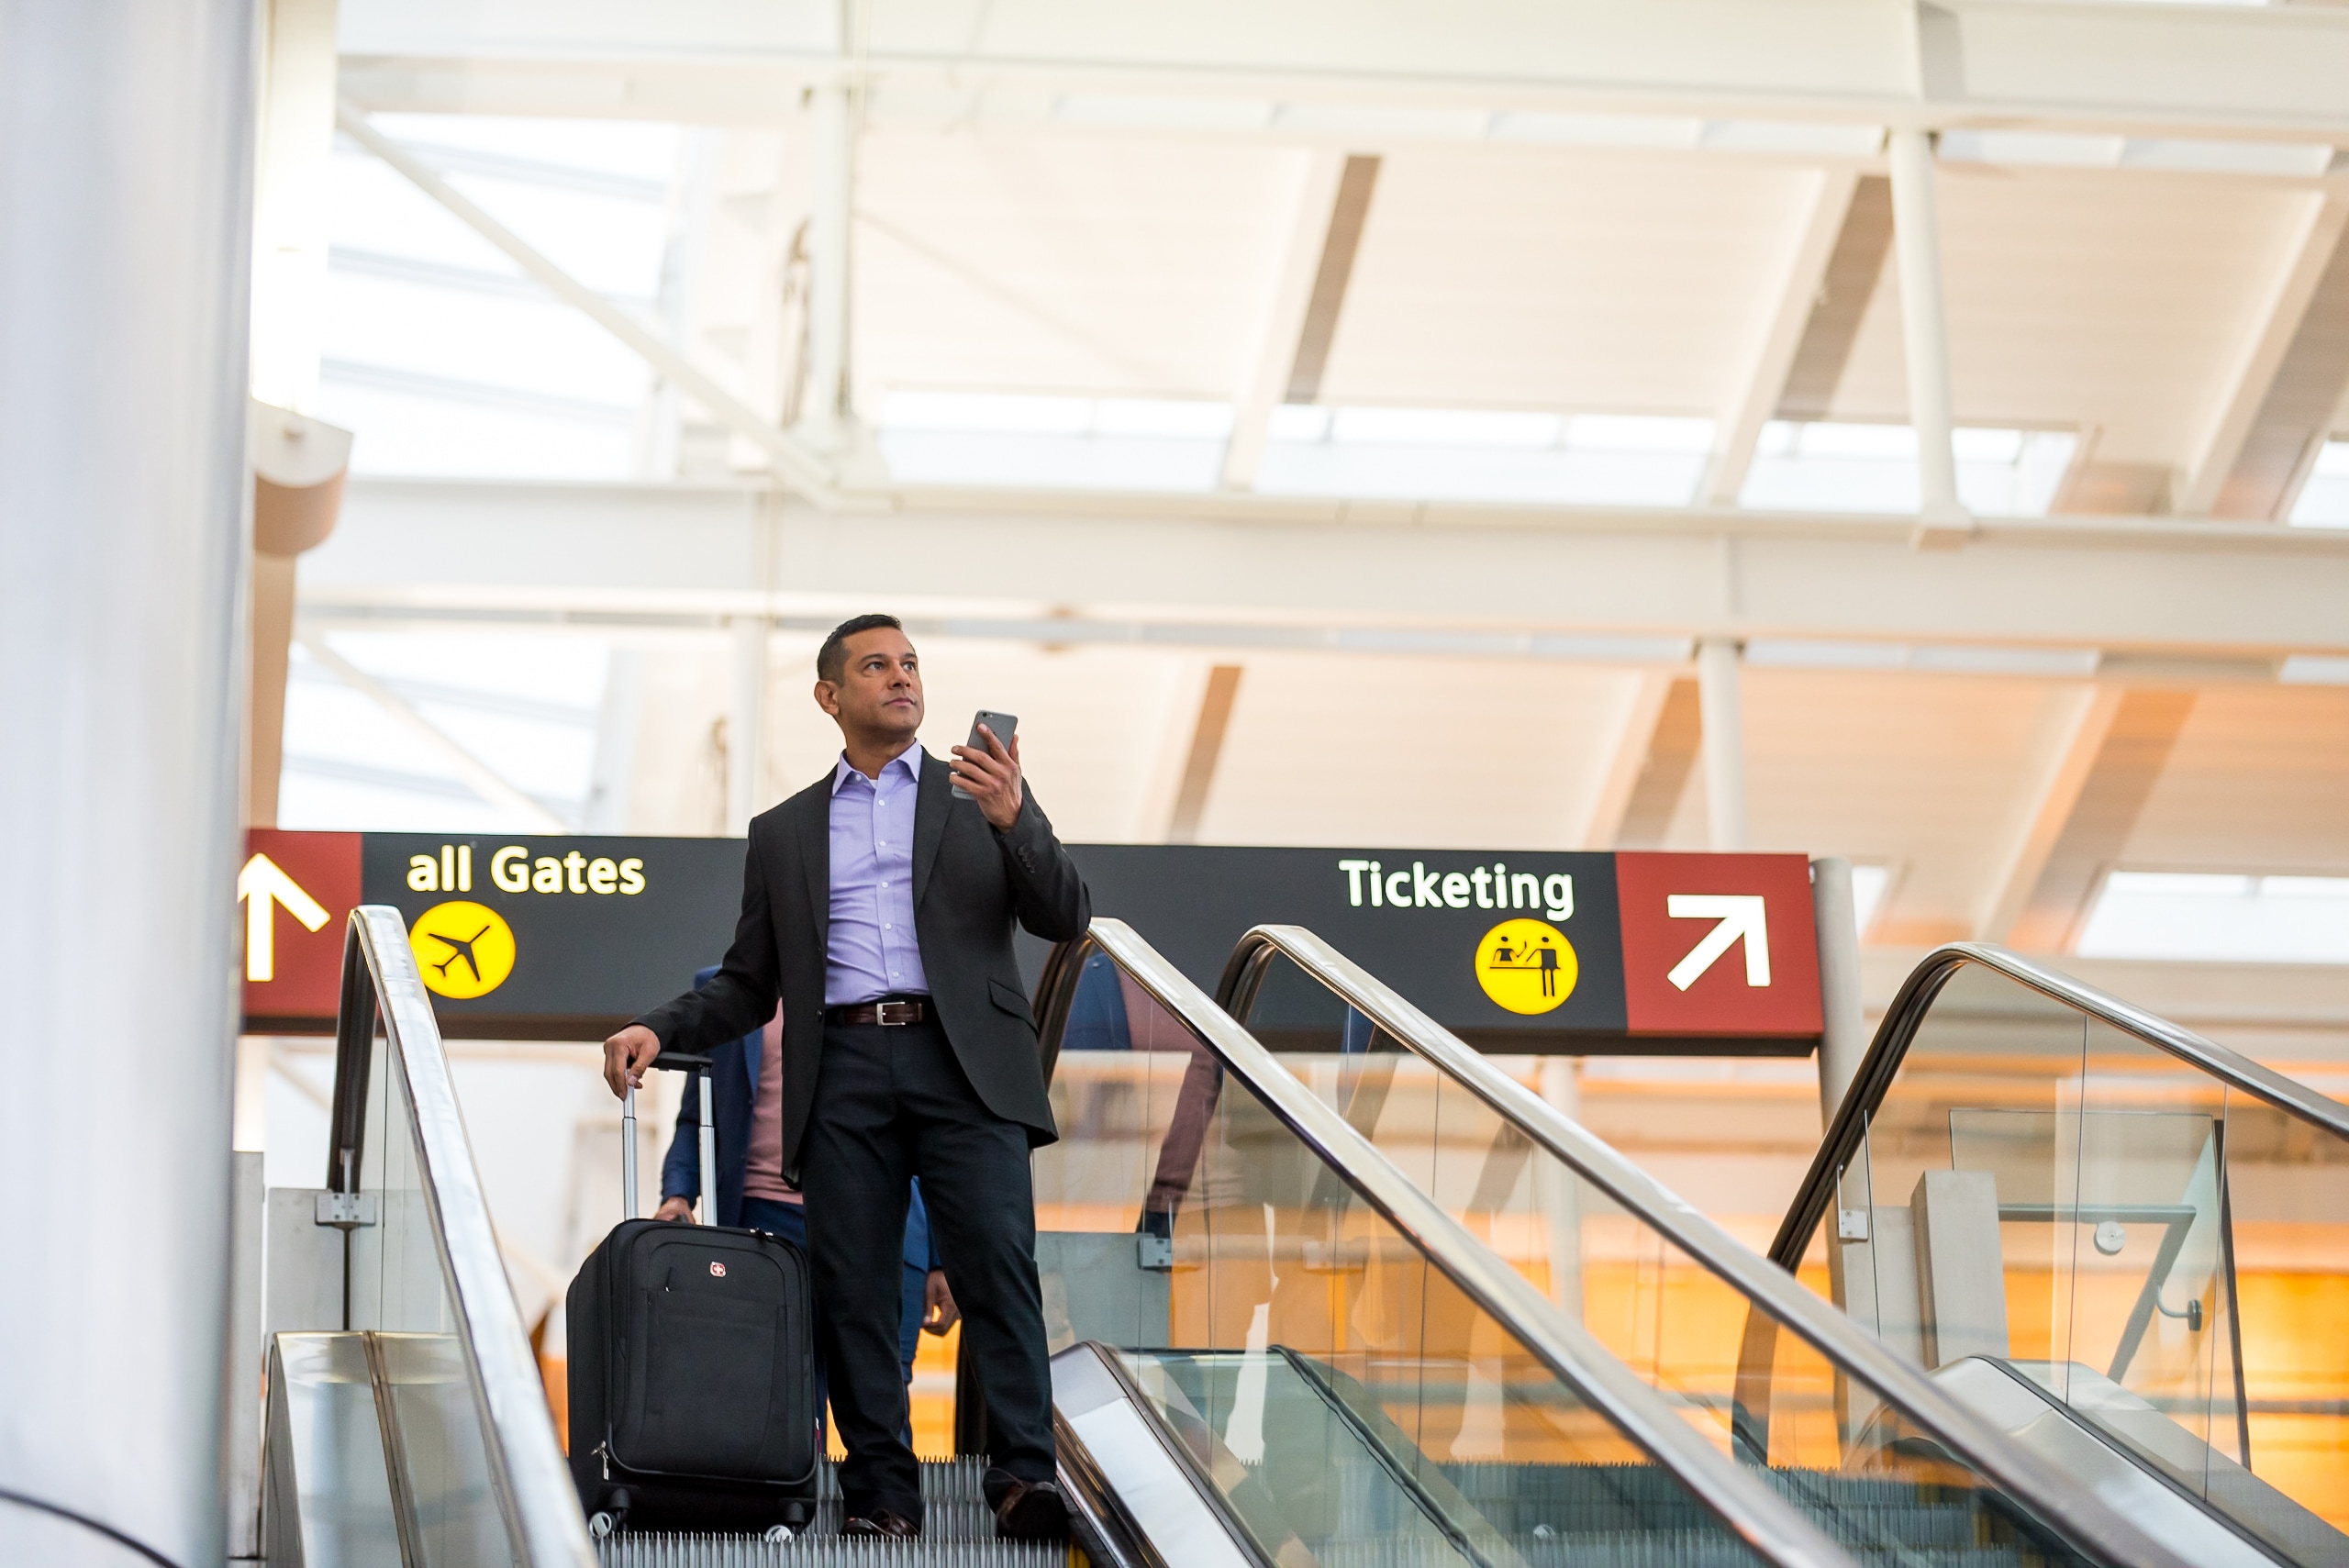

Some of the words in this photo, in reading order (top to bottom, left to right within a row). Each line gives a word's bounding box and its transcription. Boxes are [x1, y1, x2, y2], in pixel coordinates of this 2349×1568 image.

[407, 844, 472, 892] all
[491, 845, 646, 895] Gates
[1338, 859, 1575, 922] Ticketing
